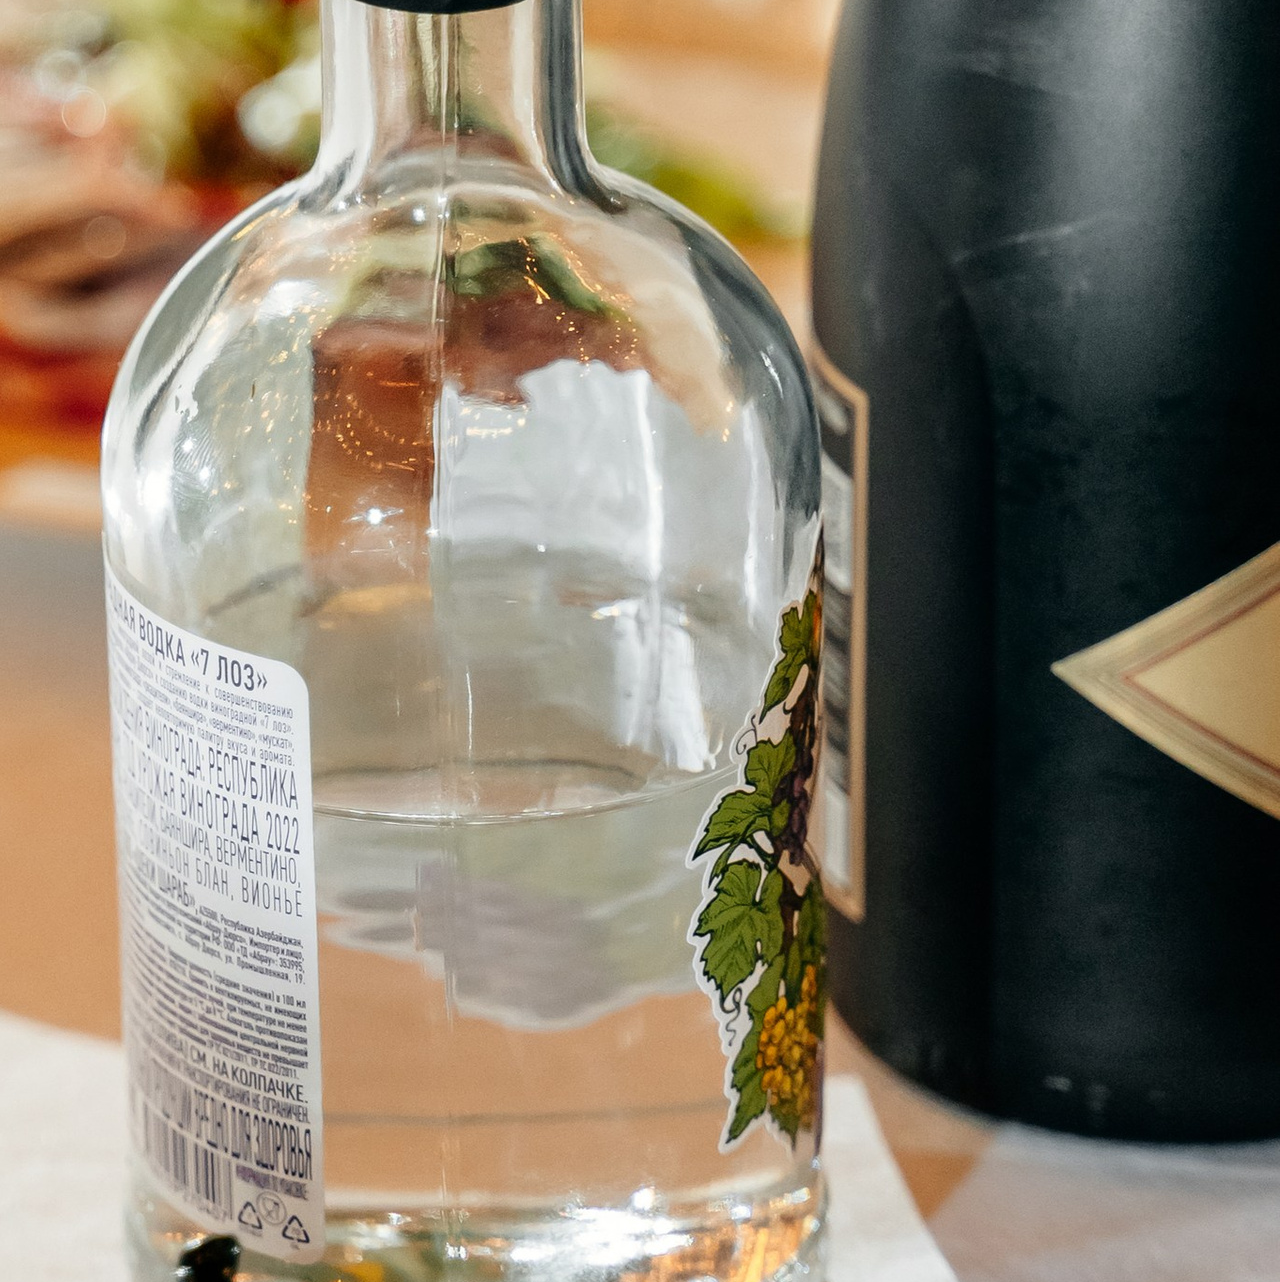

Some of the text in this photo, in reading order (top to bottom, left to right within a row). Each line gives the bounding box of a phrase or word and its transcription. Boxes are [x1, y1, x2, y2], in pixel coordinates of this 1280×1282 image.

[139, 612, 185, 669] ВОДКА
[190, 643, 209, 676] «7
[216, 654, 267, 694] ЛОЗ»
[210, 700, 256, 726] виноградной
[214, 687, 292, 720] совершенствованию
[227, 739, 247, 757] вкуса
[259, 748, 294, 768] аромата.
[208, 746, 298, 809] РЕСПУБЛИКА
[180, 777, 259, 847] ВИНОГРАДА
[265, 810, 299, 855] 2022
[216, 835, 300, 888] ВЕРМЕНТИНО,
[195, 856, 233, 901] БЛАН,
[241, 875, 302, 917] ВИОНЬЕ
[220, 913, 254, 937] Республика
[255, 925, 303, 948] Азербайджан,
[278, 956, 304, 973] 353995,
[294, 972, 305, 985] 19.
[212, 1055, 228, 1078] НА
[231, 1062, 308, 1104] КОЛПАЧКЕ.
[262, 1095, 310, 1124] ОГРАНИЧЕН.
[253, 1112, 312, 1181] ЗДОРОВЬЯ
